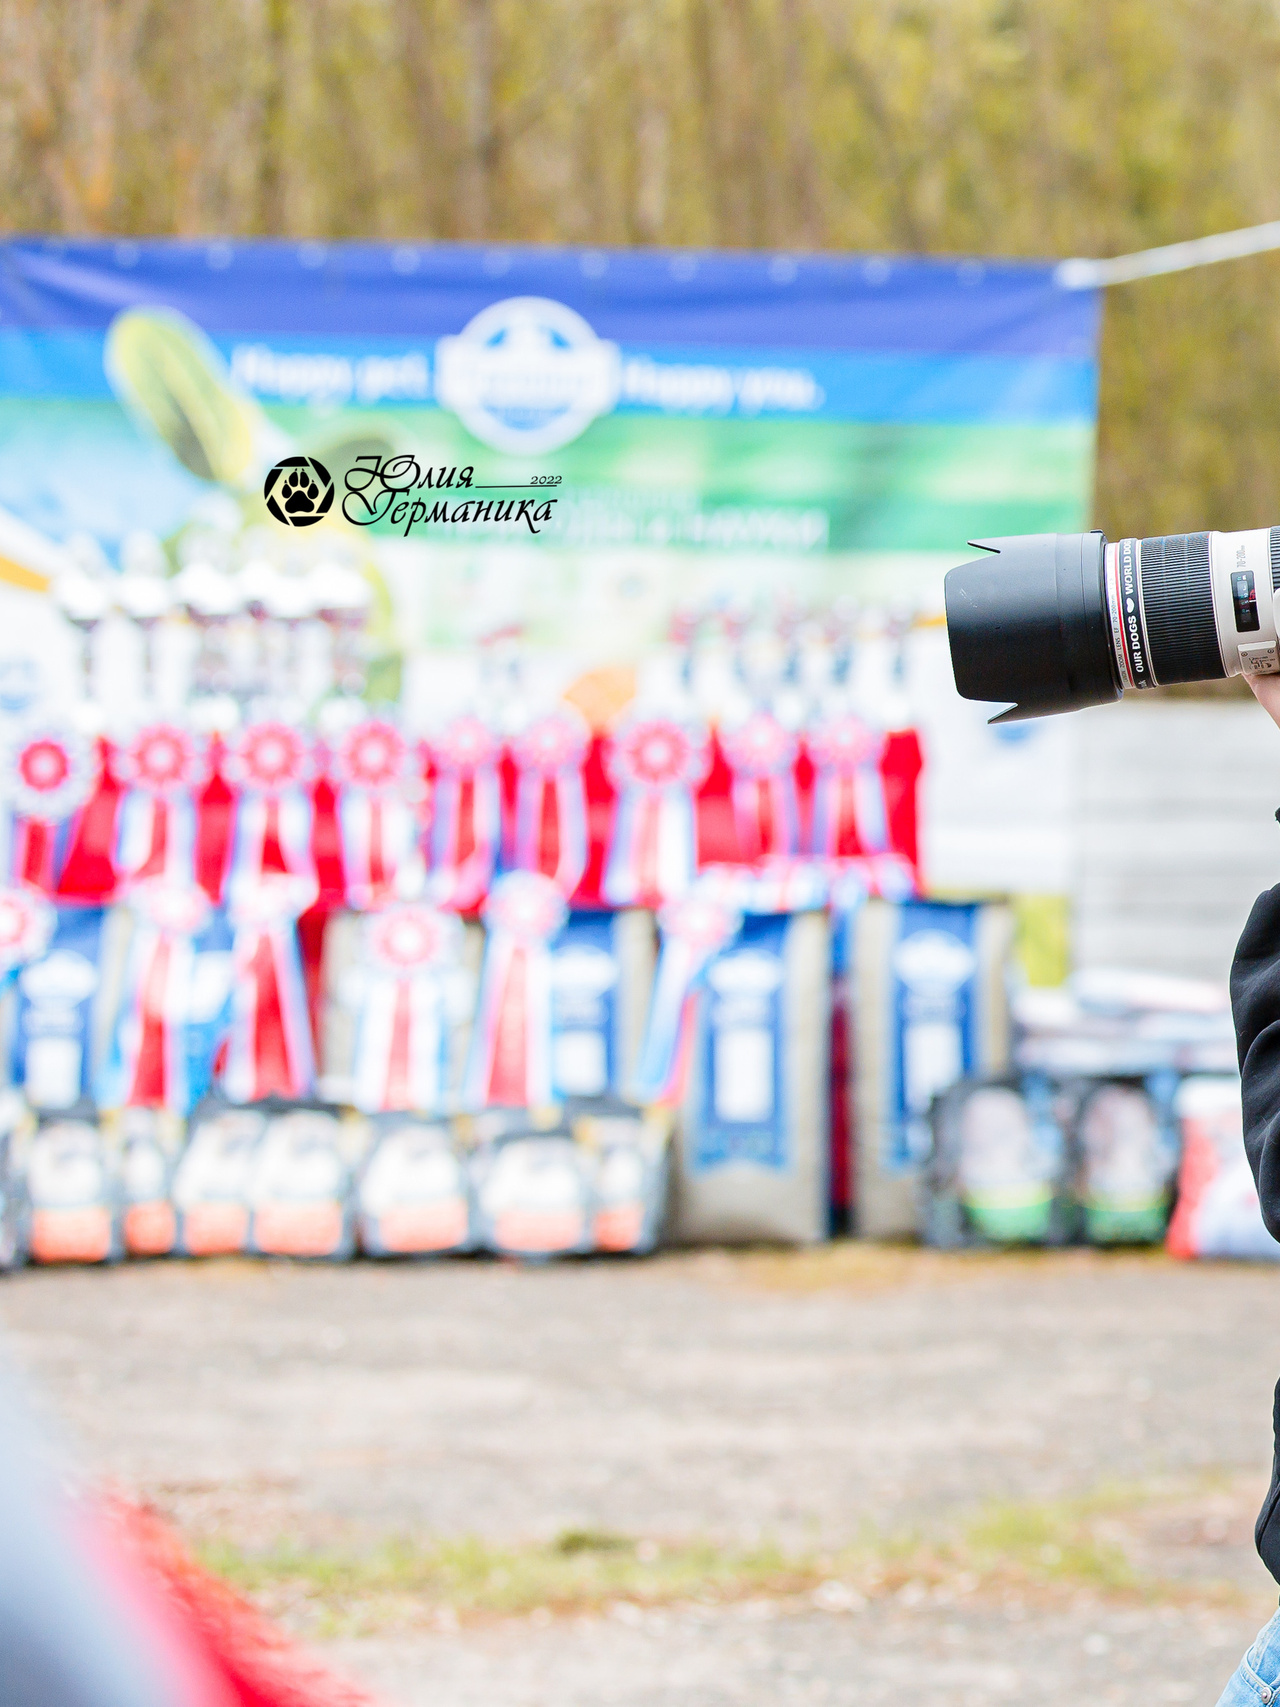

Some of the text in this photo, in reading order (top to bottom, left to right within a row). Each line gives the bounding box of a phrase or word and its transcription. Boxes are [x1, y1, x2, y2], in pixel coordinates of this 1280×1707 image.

[1123, 556, 1134, 595] WORLD
[1128, 615, 1141, 650] DOGS
[1133, 651, 1144, 673] OUR
